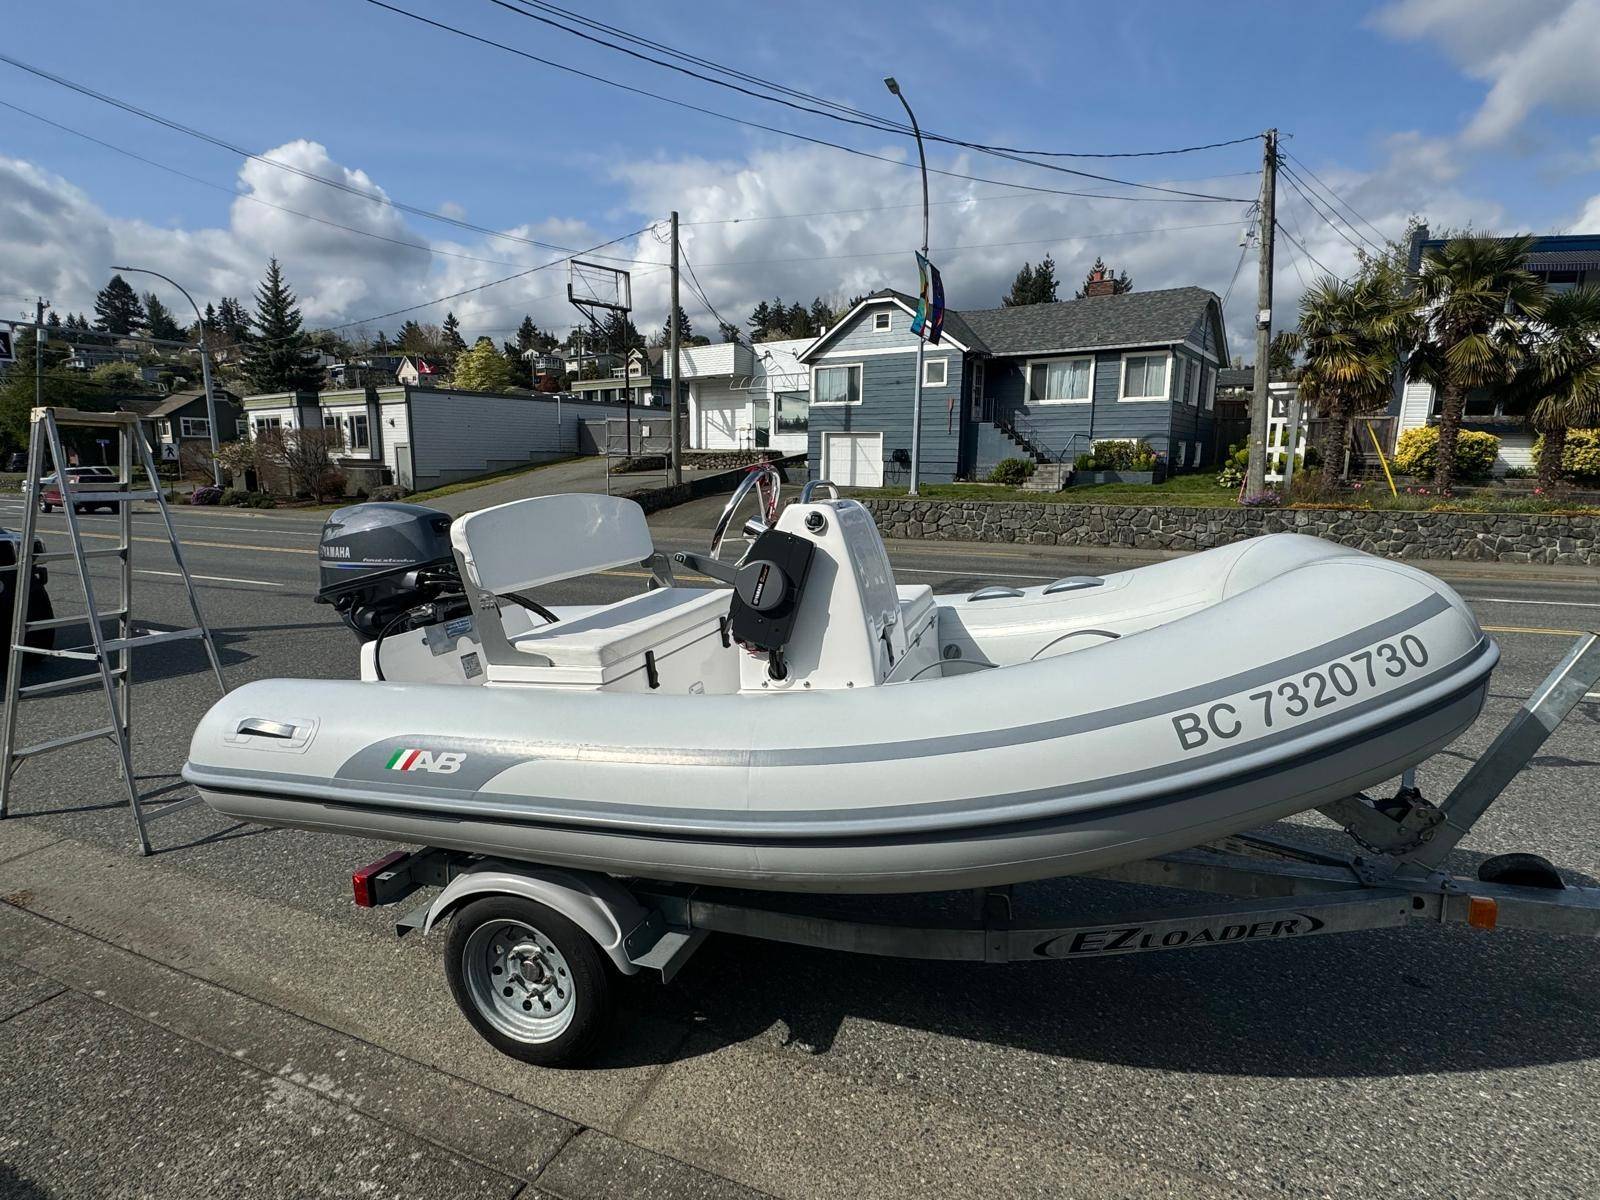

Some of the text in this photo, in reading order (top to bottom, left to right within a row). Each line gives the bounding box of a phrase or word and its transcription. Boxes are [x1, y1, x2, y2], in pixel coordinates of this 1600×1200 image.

[323, 546, 351, 559] YAMAHA
[1171, 634, 1429, 751] BC 7320730
[407, 750, 467, 774] AB
